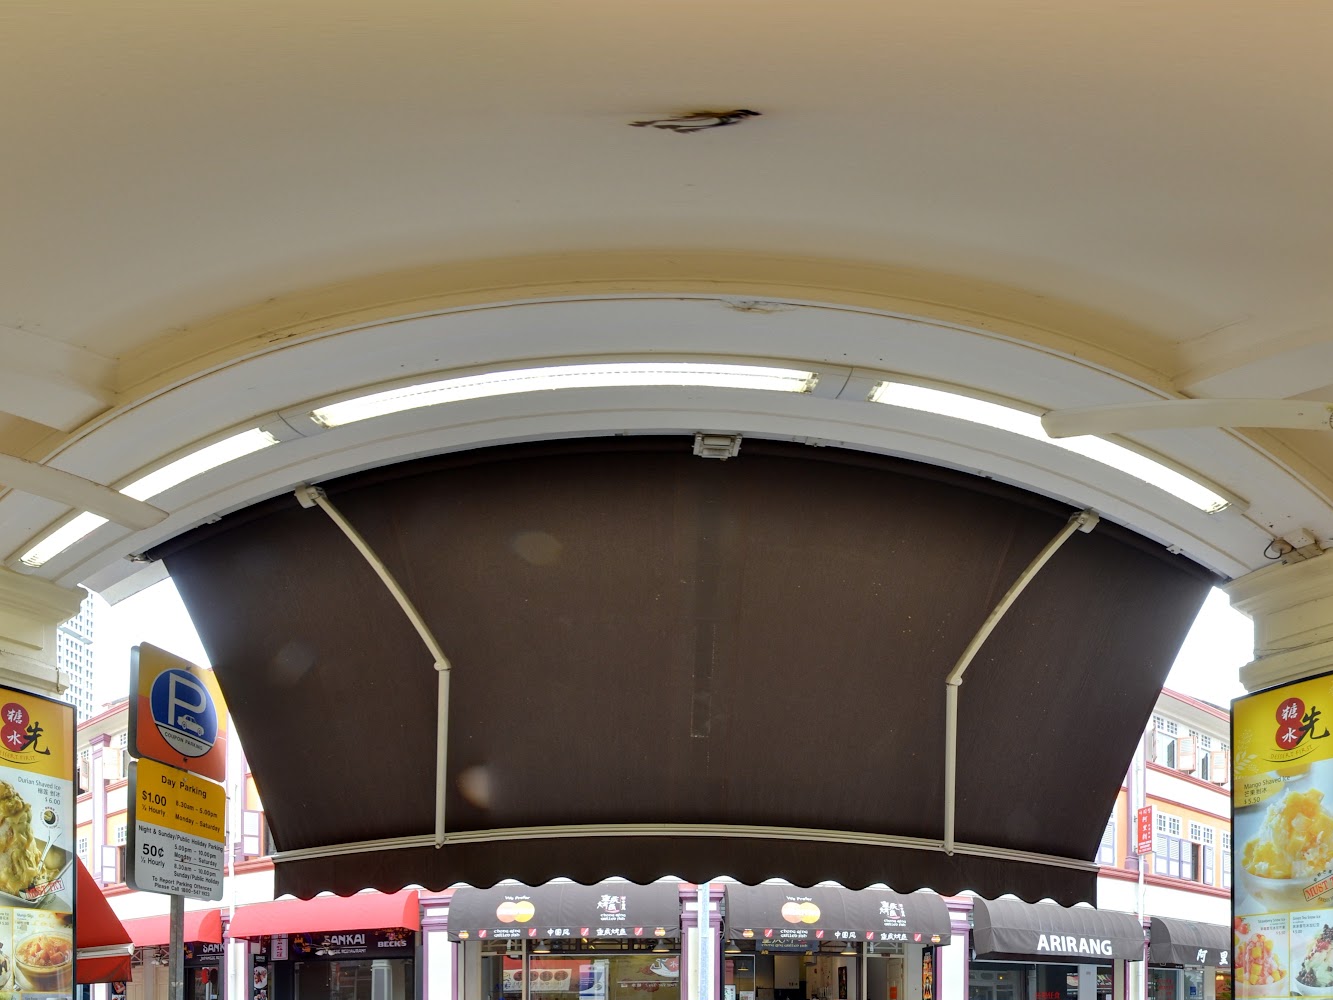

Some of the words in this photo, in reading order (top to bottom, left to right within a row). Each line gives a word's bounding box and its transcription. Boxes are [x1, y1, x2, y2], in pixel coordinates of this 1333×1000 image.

[164, 731, 184, 743] COUPON
[184, 738, 203, 751] PARKING
[17, 776, 35, 786] Durian
[35, 779, 53, 790] Shaved
[161, 775, 177, 789] Day
[179, 781, 207, 799] Parking
[1243, 780, 1262, 790] Mango
[1262, 777, 1282, 786] Shaved
[142, 790, 167, 807] $1.00
[148, 805, 166, 817] Hourly
[175, 800, 195, 811] 8.30am
[199, 806, 218, 819] 5.00pm
[174, 813, 195, 826] Monday
[199, 821, 220, 833] Saturday
[138, 824, 152, 834] Night
[158, 829, 190, 844] Sunday/Public
[191, 838, 208, 848] Holiday
[208, 843, 224, 854] Parking
[142, 843, 165, 858] 50¢
[147, 858, 165, 868] Hourly
[174, 852, 192, 861] Monday
[198, 857, 217, 868] Saturday
[159, 876, 175, 885] Report
[176, 879, 193, 889] Parking
[1304, 881, 1328, 899] MUST
[203, 943, 225, 954] SANK
[1036, 933, 1113, 956] ARIRANG
